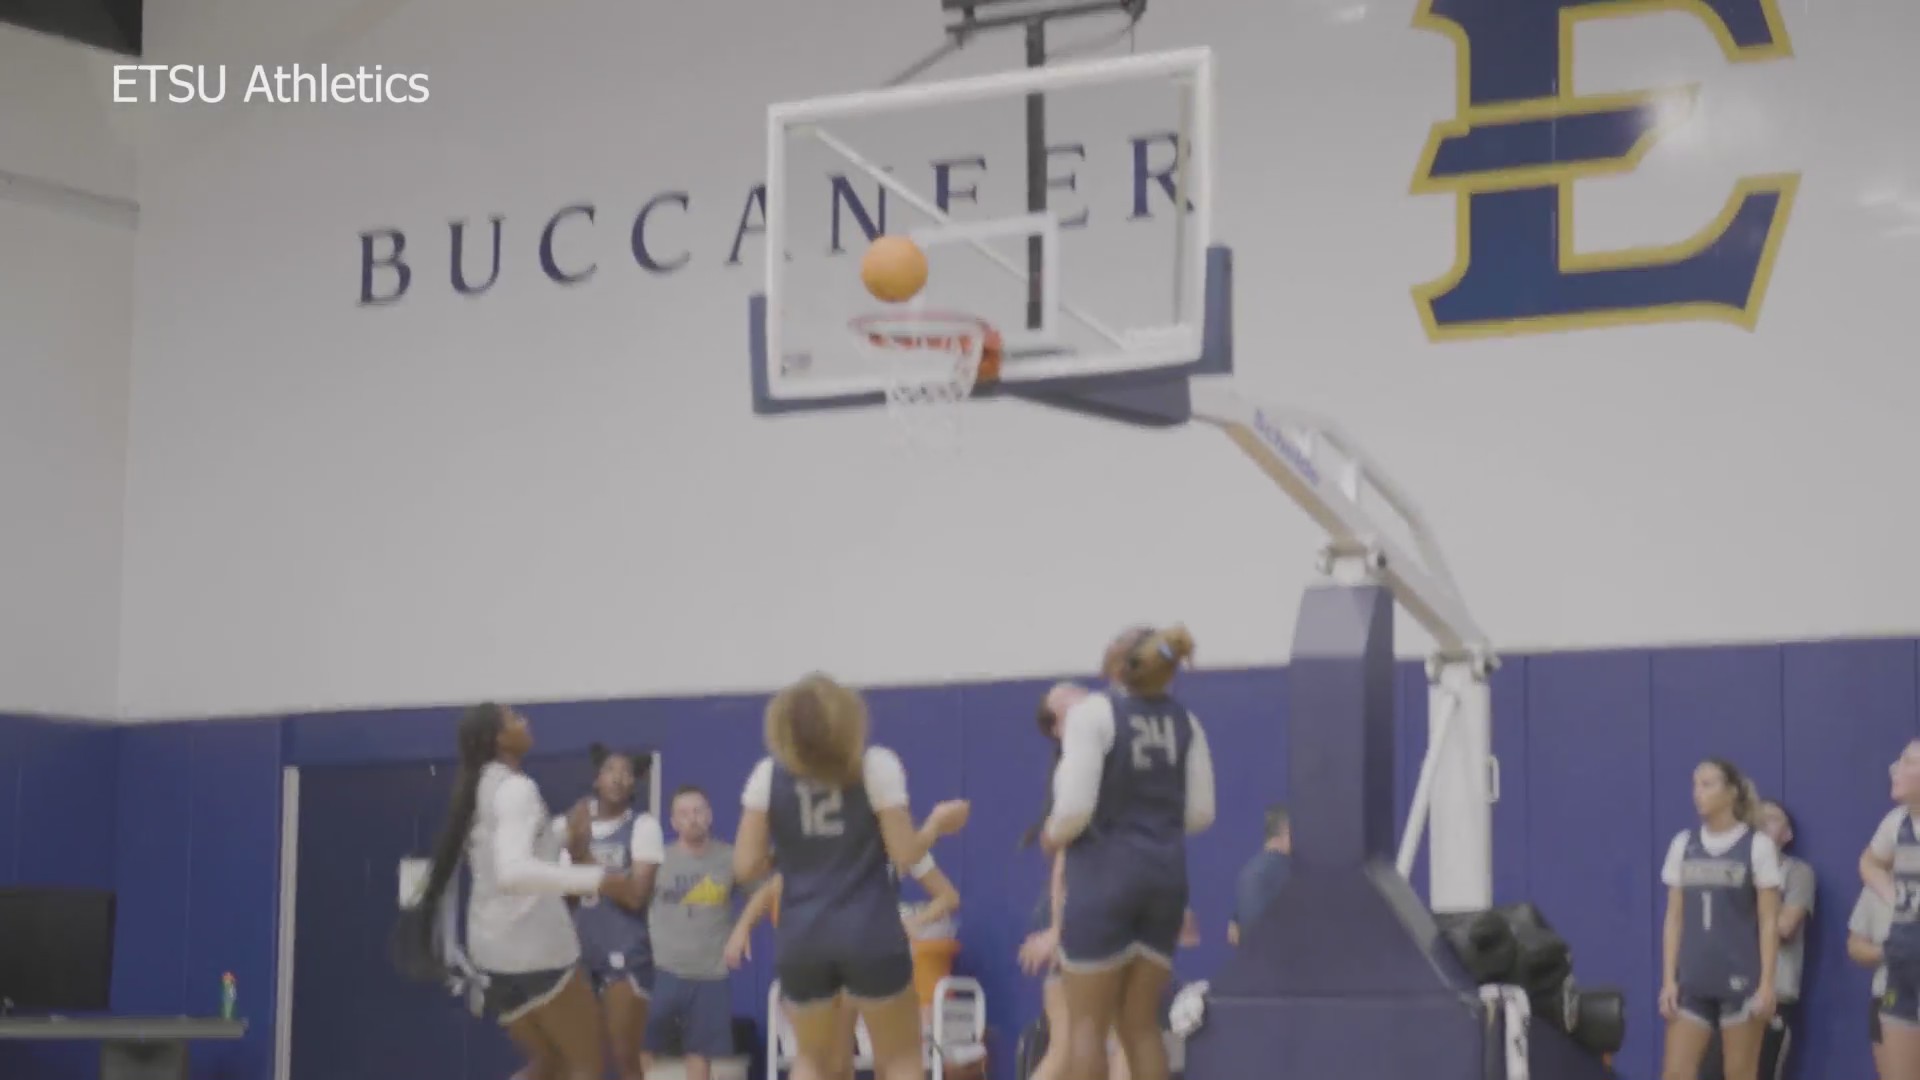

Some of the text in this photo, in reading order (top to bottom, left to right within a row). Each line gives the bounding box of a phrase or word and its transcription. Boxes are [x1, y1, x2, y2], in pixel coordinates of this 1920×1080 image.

[1129, 713, 1177, 771] 24
[795, 781, 844, 837] 12
[1701, 889, 1713, 931] 1
